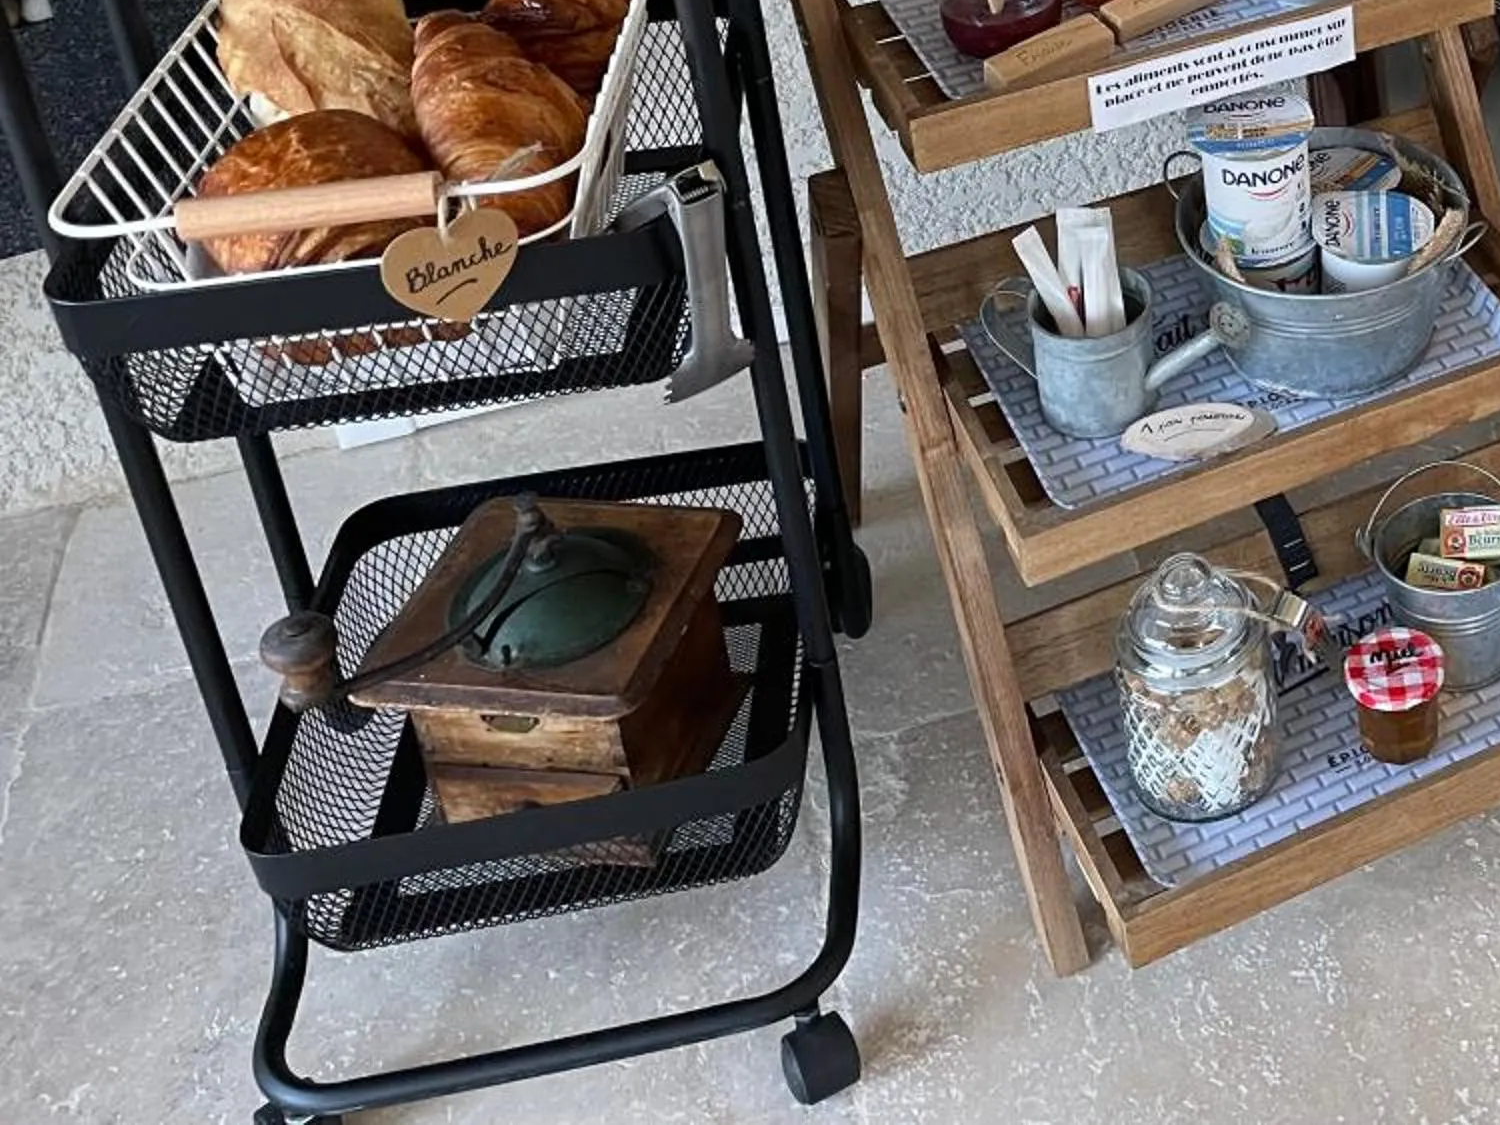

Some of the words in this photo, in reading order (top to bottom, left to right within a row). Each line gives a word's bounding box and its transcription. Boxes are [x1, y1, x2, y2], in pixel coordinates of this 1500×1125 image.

[1095, 81, 1121, 95] Les
[1124, 61, 1190, 88] aliments
[1193, 51, 1223, 67] sont
[1227, 47, 1236, 58] à
[1239, 26, 1322, 54] consommer
[1327, 19, 1346, 32] sur
[1105, 89, 1145, 108] place
[1148, 82, 1162, 94] et
[1165, 78, 1185, 90] ne
[1187, 58, 1248, 84] peuvent
[1250, 50, 1283, 66] donc
[1288, 43, 1314, 57] pas
[1316, 34, 1343, 48] être
[1203, 96, 1286, 114] DANONE
[1221, 153, 1306, 187] DANONE
[404, 235, 513, 294] Blanche
[1369, 642, 1424, 664] Miel
